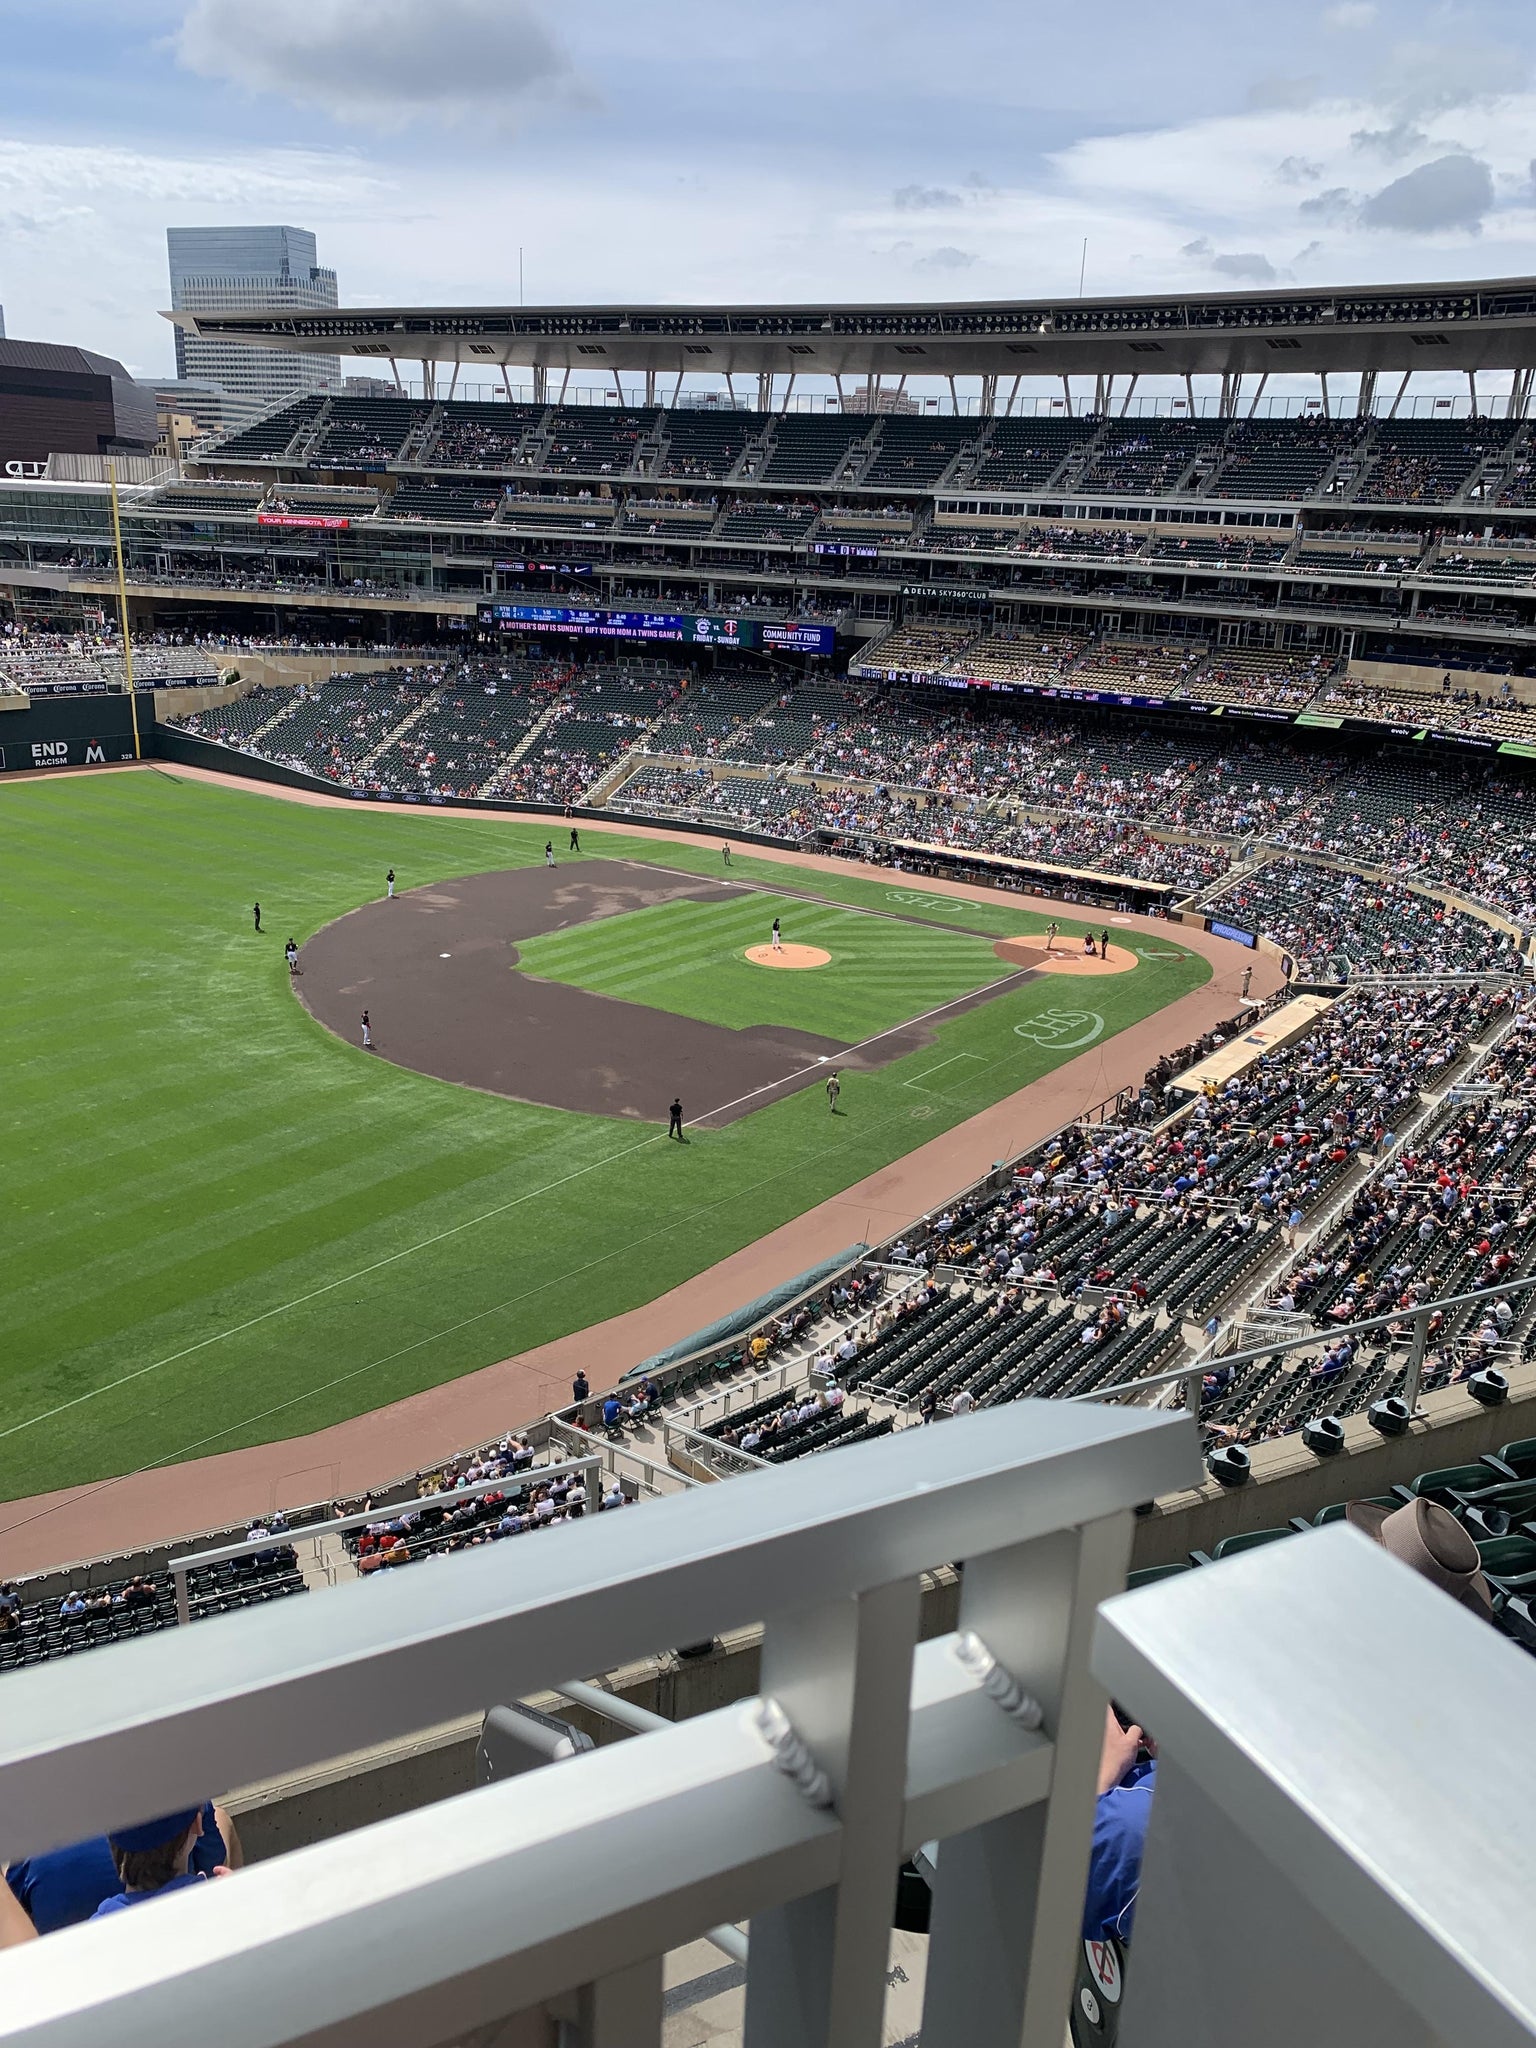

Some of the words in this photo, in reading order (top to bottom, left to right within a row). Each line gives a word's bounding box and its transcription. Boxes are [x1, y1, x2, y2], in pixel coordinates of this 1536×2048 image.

[506, 622, 536, 630] MOTHER'S
[693, 634, 713, 642] FRIDAY
[718, 636, 740, 644] SUNDAY
[763, 630, 802, 640] COMMUNITY
[804, 633, 820, 642] FUND
[31, 742, 68, 757] END
[35, 757, 67, 766] RACISM
[1214, 924, 1252, 944] PROGRESSIVE
